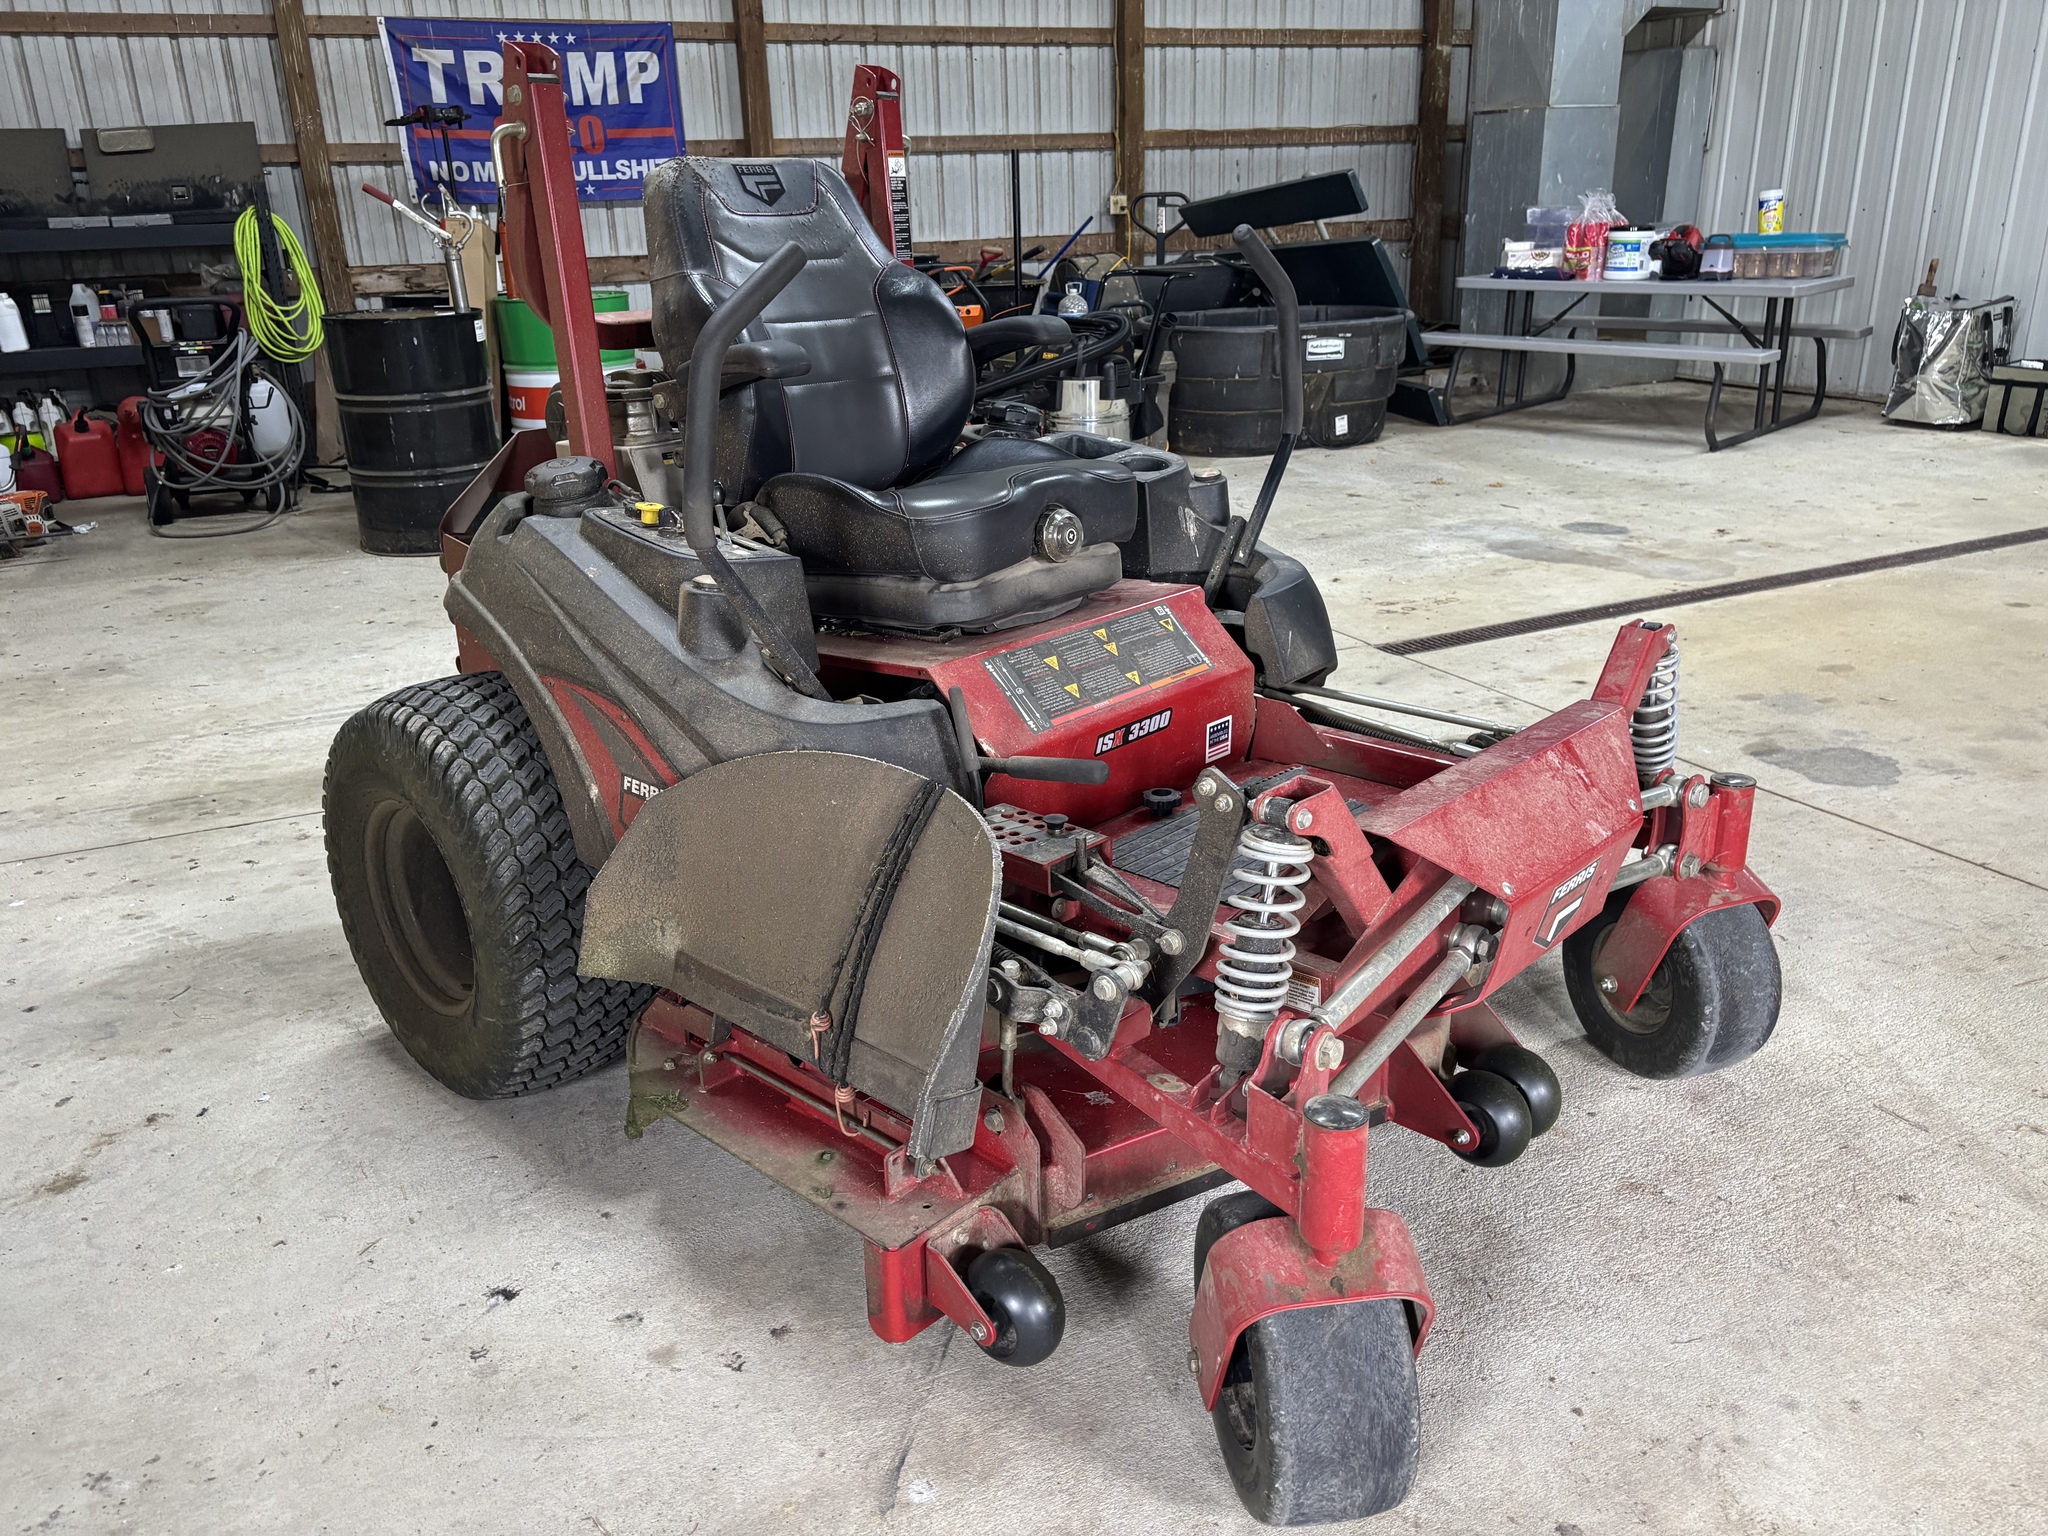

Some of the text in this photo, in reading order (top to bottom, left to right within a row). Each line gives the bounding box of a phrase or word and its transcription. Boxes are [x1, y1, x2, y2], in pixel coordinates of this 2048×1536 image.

[412, 48, 660, 106] TRMP
[429, 161, 470, 182] NO
[572, 158, 669, 181] ULLSHI
[736, 165, 774, 174] FERRIS
[1095, 710, 1171, 755] ISX 3300
[623, 775, 664, 800] FERR
[1551, 862, 1598, 905] FERRIS
